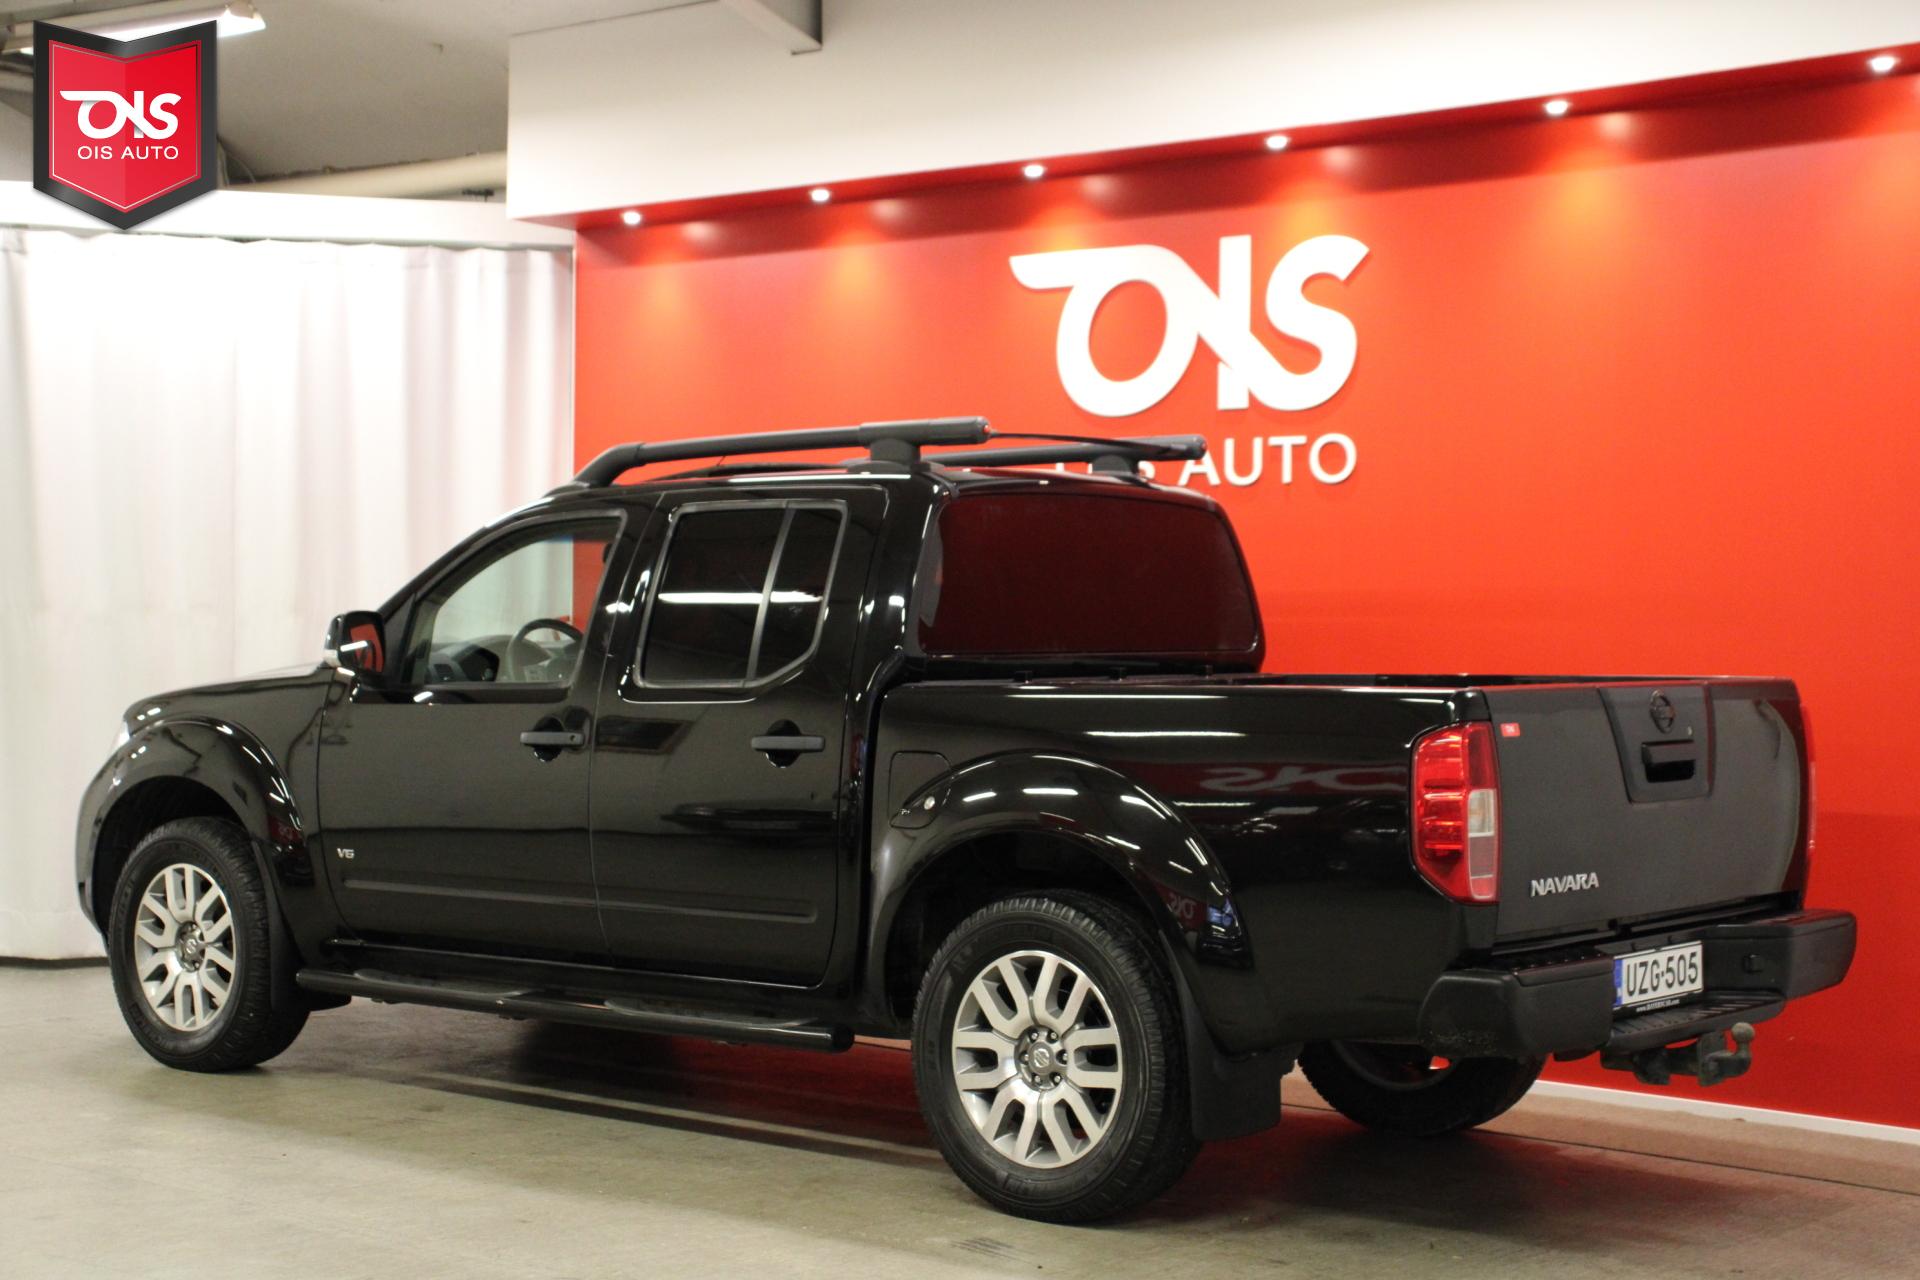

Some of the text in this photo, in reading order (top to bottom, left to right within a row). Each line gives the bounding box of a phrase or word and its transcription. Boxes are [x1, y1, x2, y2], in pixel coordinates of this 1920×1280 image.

[1178, 432, 1357, 486] AUTO
[336, 847, 355, 859] V6
[1531, 872, 1599, 897] NAVARA
[1626, 951, 1699, 997] UZG-505
